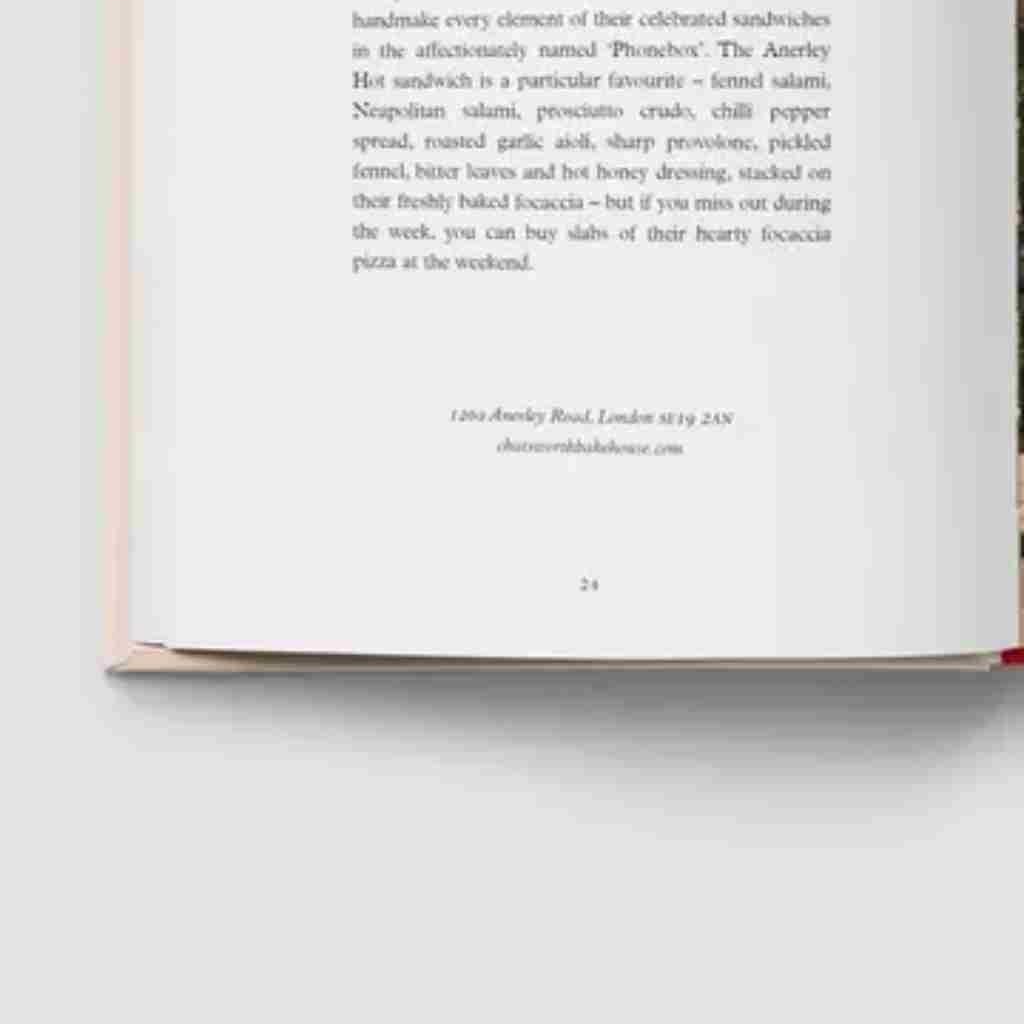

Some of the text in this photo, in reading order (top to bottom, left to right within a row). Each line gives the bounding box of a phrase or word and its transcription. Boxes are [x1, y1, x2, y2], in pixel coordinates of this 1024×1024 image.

[352, 11, 831, 31] handmake every element their celebrated sandwiches
[378, 40, 831, 62] the affectionately named The Anerley
[352, 71, 386, 89] Hot
[392, 72, 473, 89] sandwich
[517, 72, 602, 91] particular
[608, 72, 685, 89] favourite
[710, 72, 764, 89] fennel
[352, 101, 446, 123] Neapolitan
[536, 104, 624, 123] prosciutto
[711, 102, 753, 120] chilli
[770, 106, 831, 124] pepper
[424, 132, 832, 154] roasted garlic sharp pickled
[415, 163, 803, 184] bitter leaves and hot honey stacked
[352, 193, 832, 215] their freshly baked focaccia but you miss out during
[352, 222, 832, 246] the you can buy slabs their hearty focaccia
[352, 253, 451, 274] pizza the
[597, 409, 654, 424] London
